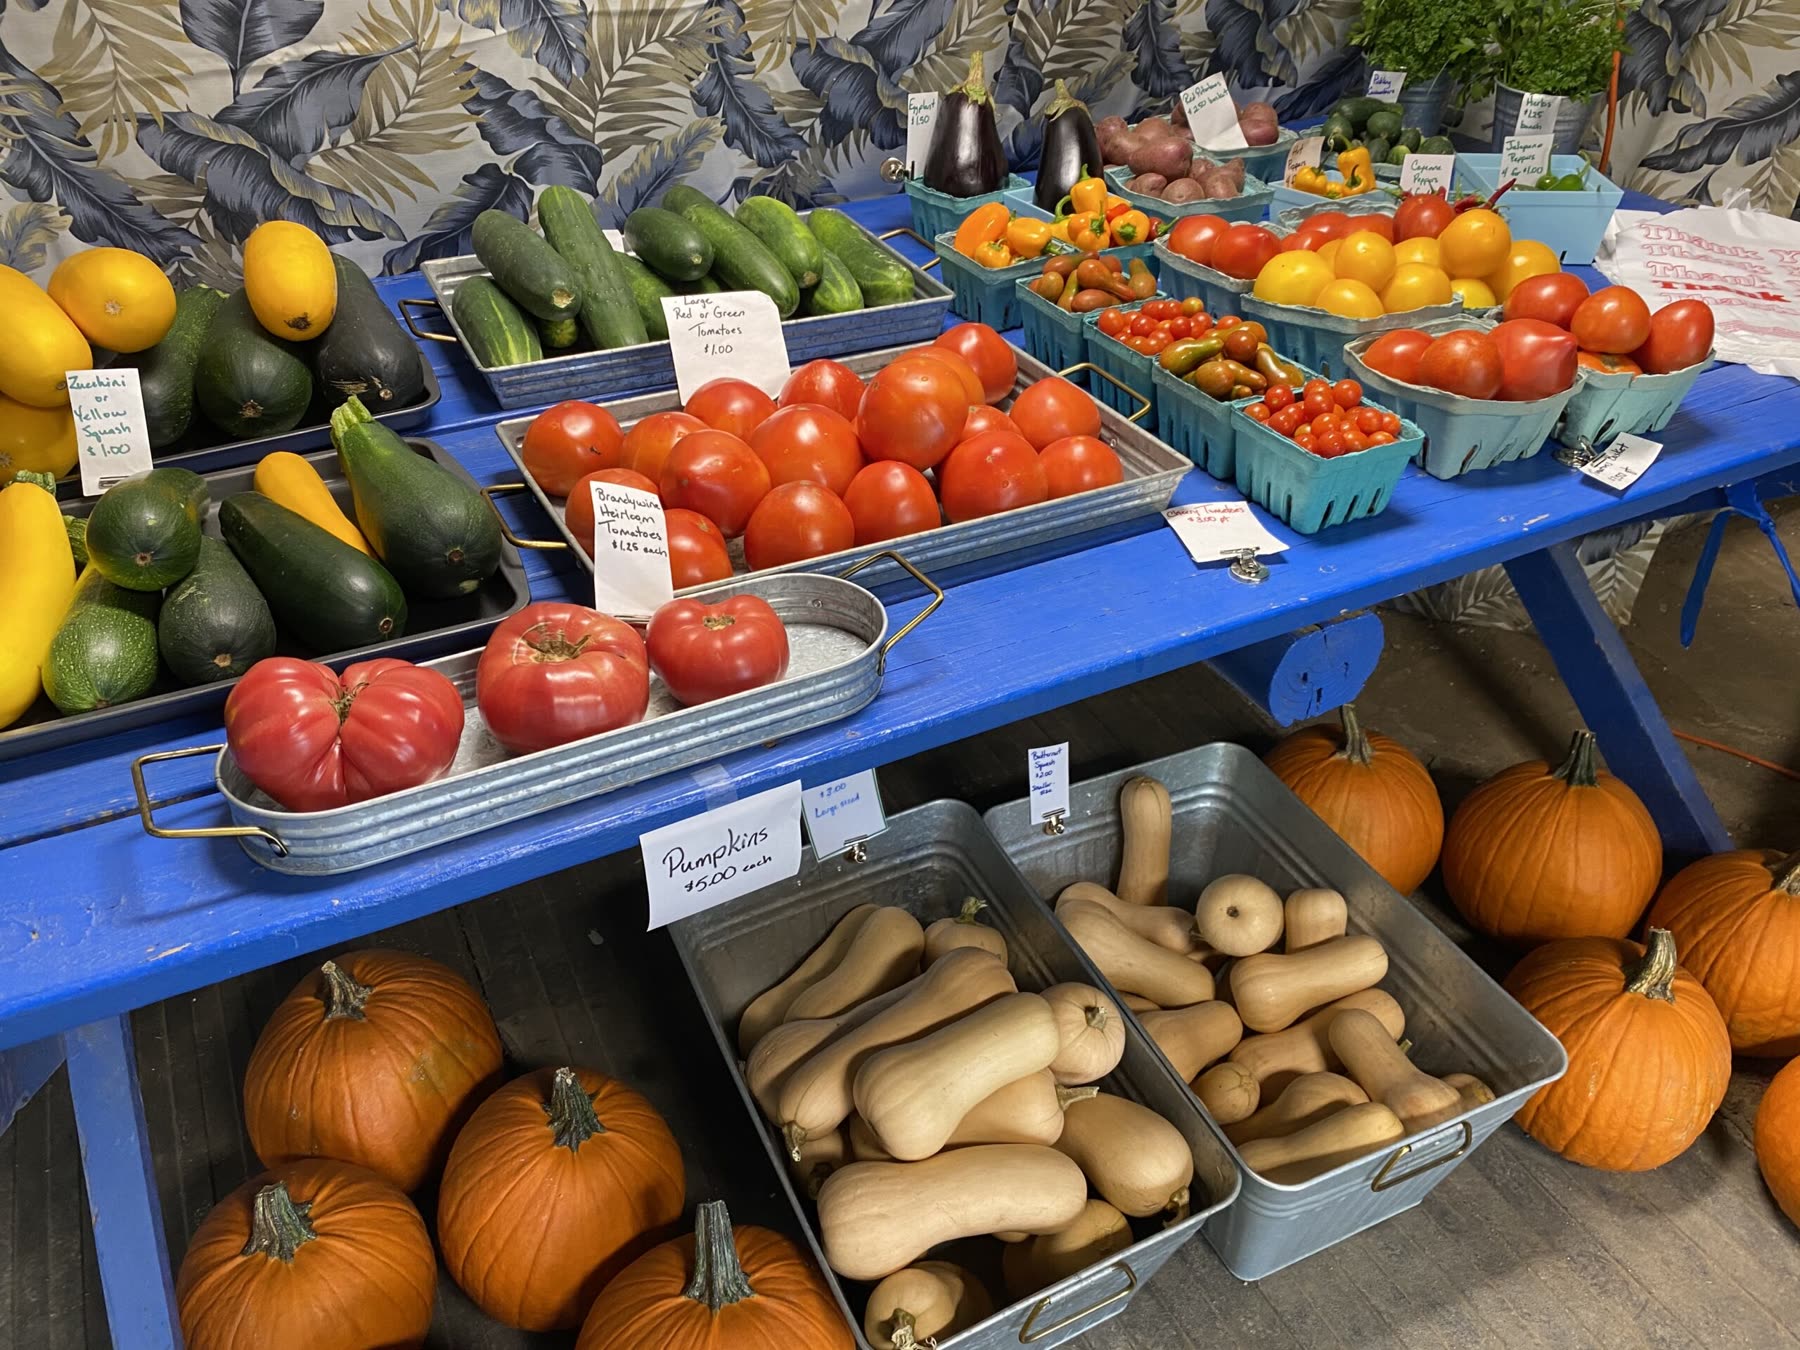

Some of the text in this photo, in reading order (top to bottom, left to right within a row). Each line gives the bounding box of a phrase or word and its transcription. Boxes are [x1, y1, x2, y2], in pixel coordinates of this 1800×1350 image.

[909, 98, 935, 115] Eggplant
[1526, 96, 1552, 107] Herbs
[1411, 159, 1441, 173] Cayenne
[1508, 153, 1535, 163] Peppers
[1640, 223, 1763, 260] Thank
[1646, 261, 1782, 290] Thank
[684, 296, 713, 308] Large
[673, 307, 692, 319] Red
[713, 306, 745, 318] Green
[688, 321, 742, 337] Tomatoes
[704, 344, 733, 355] $1.00
[74, 405, 127, 422] Yellow
[82, 422, 131, 443] Squash
[595, 487, 661, 510] Brandywine
[600, 503, 655, 524] Heirloom
[598, 519, 662, 541] Tomatoes
[612, 539, 668, 558] $1.25 each
[1031, 748, 1062, 760] Butternut
[1034, 760, 1055, 771] Squash
[815, 803, 839, 818] Large
[662, 827, 769, 878] Pumpkins
[684, 855, 772, 892] $5.00 each
